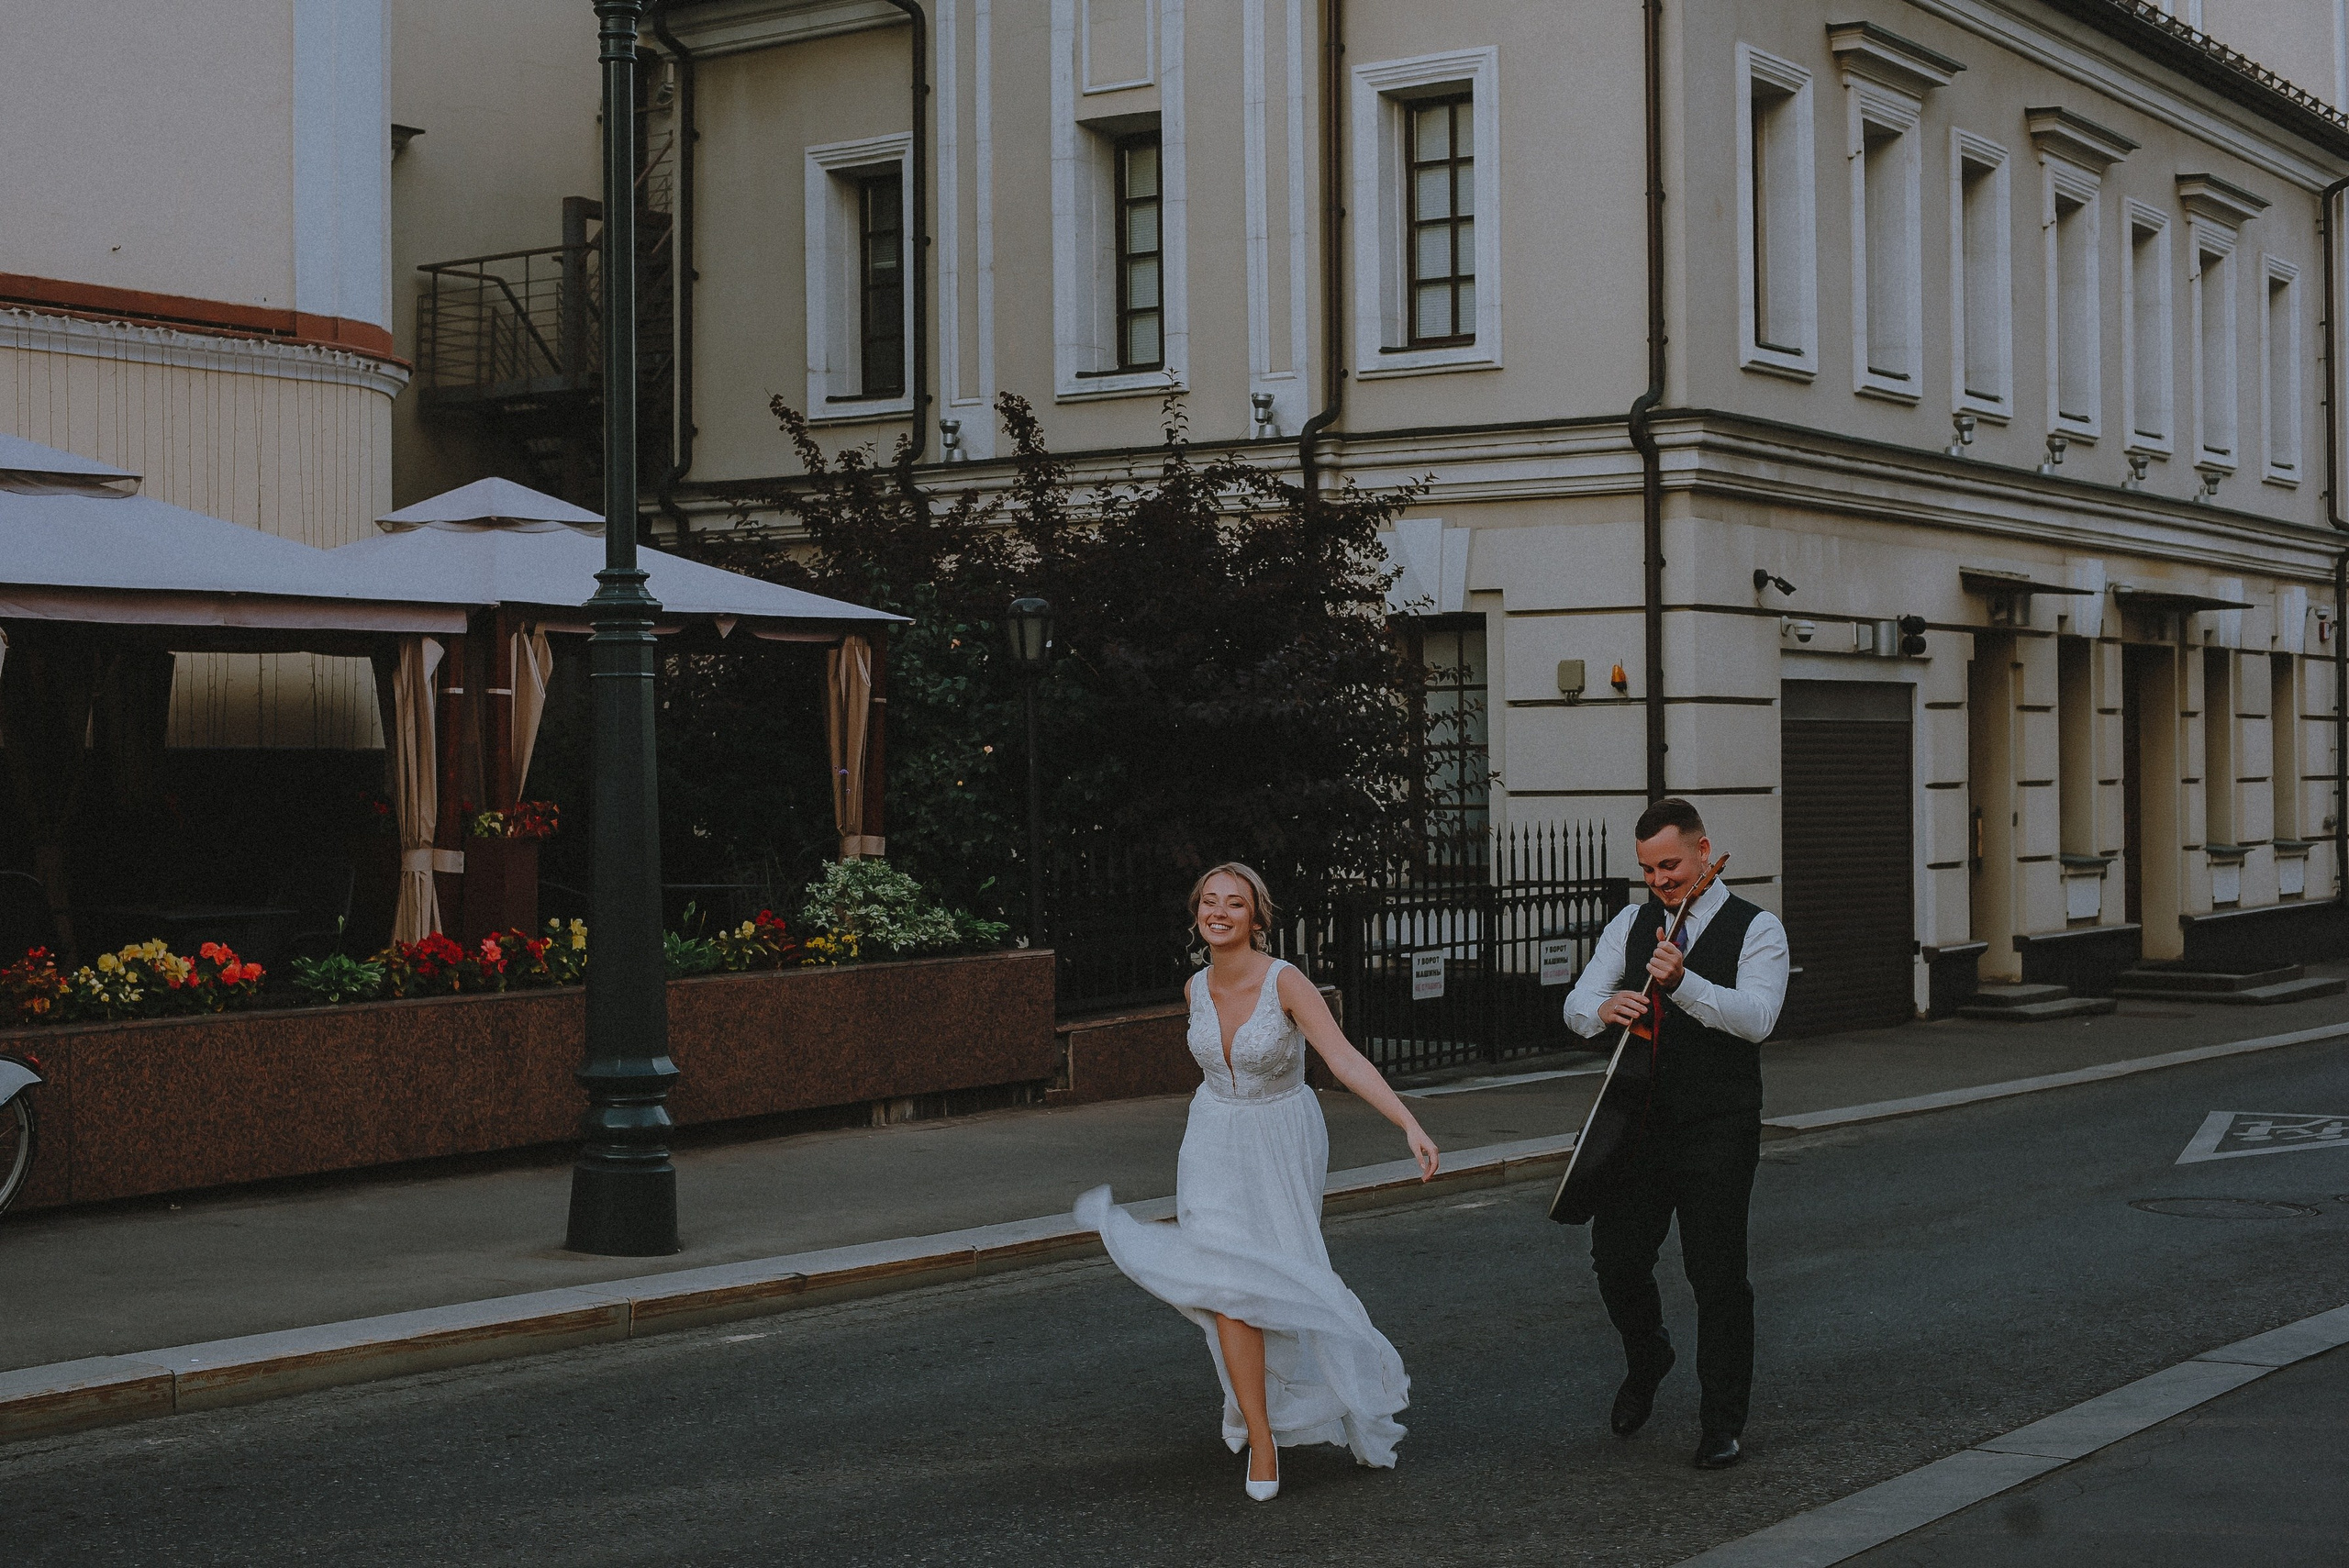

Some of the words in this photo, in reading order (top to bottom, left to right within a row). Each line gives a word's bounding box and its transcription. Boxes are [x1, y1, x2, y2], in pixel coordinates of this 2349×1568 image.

[1550, 945, 1567, 953] ВОРОТ
[1422, 956, 1439, 965] ВОРОТ
[1416, 969, 1442, 978] МАШИНЫ
